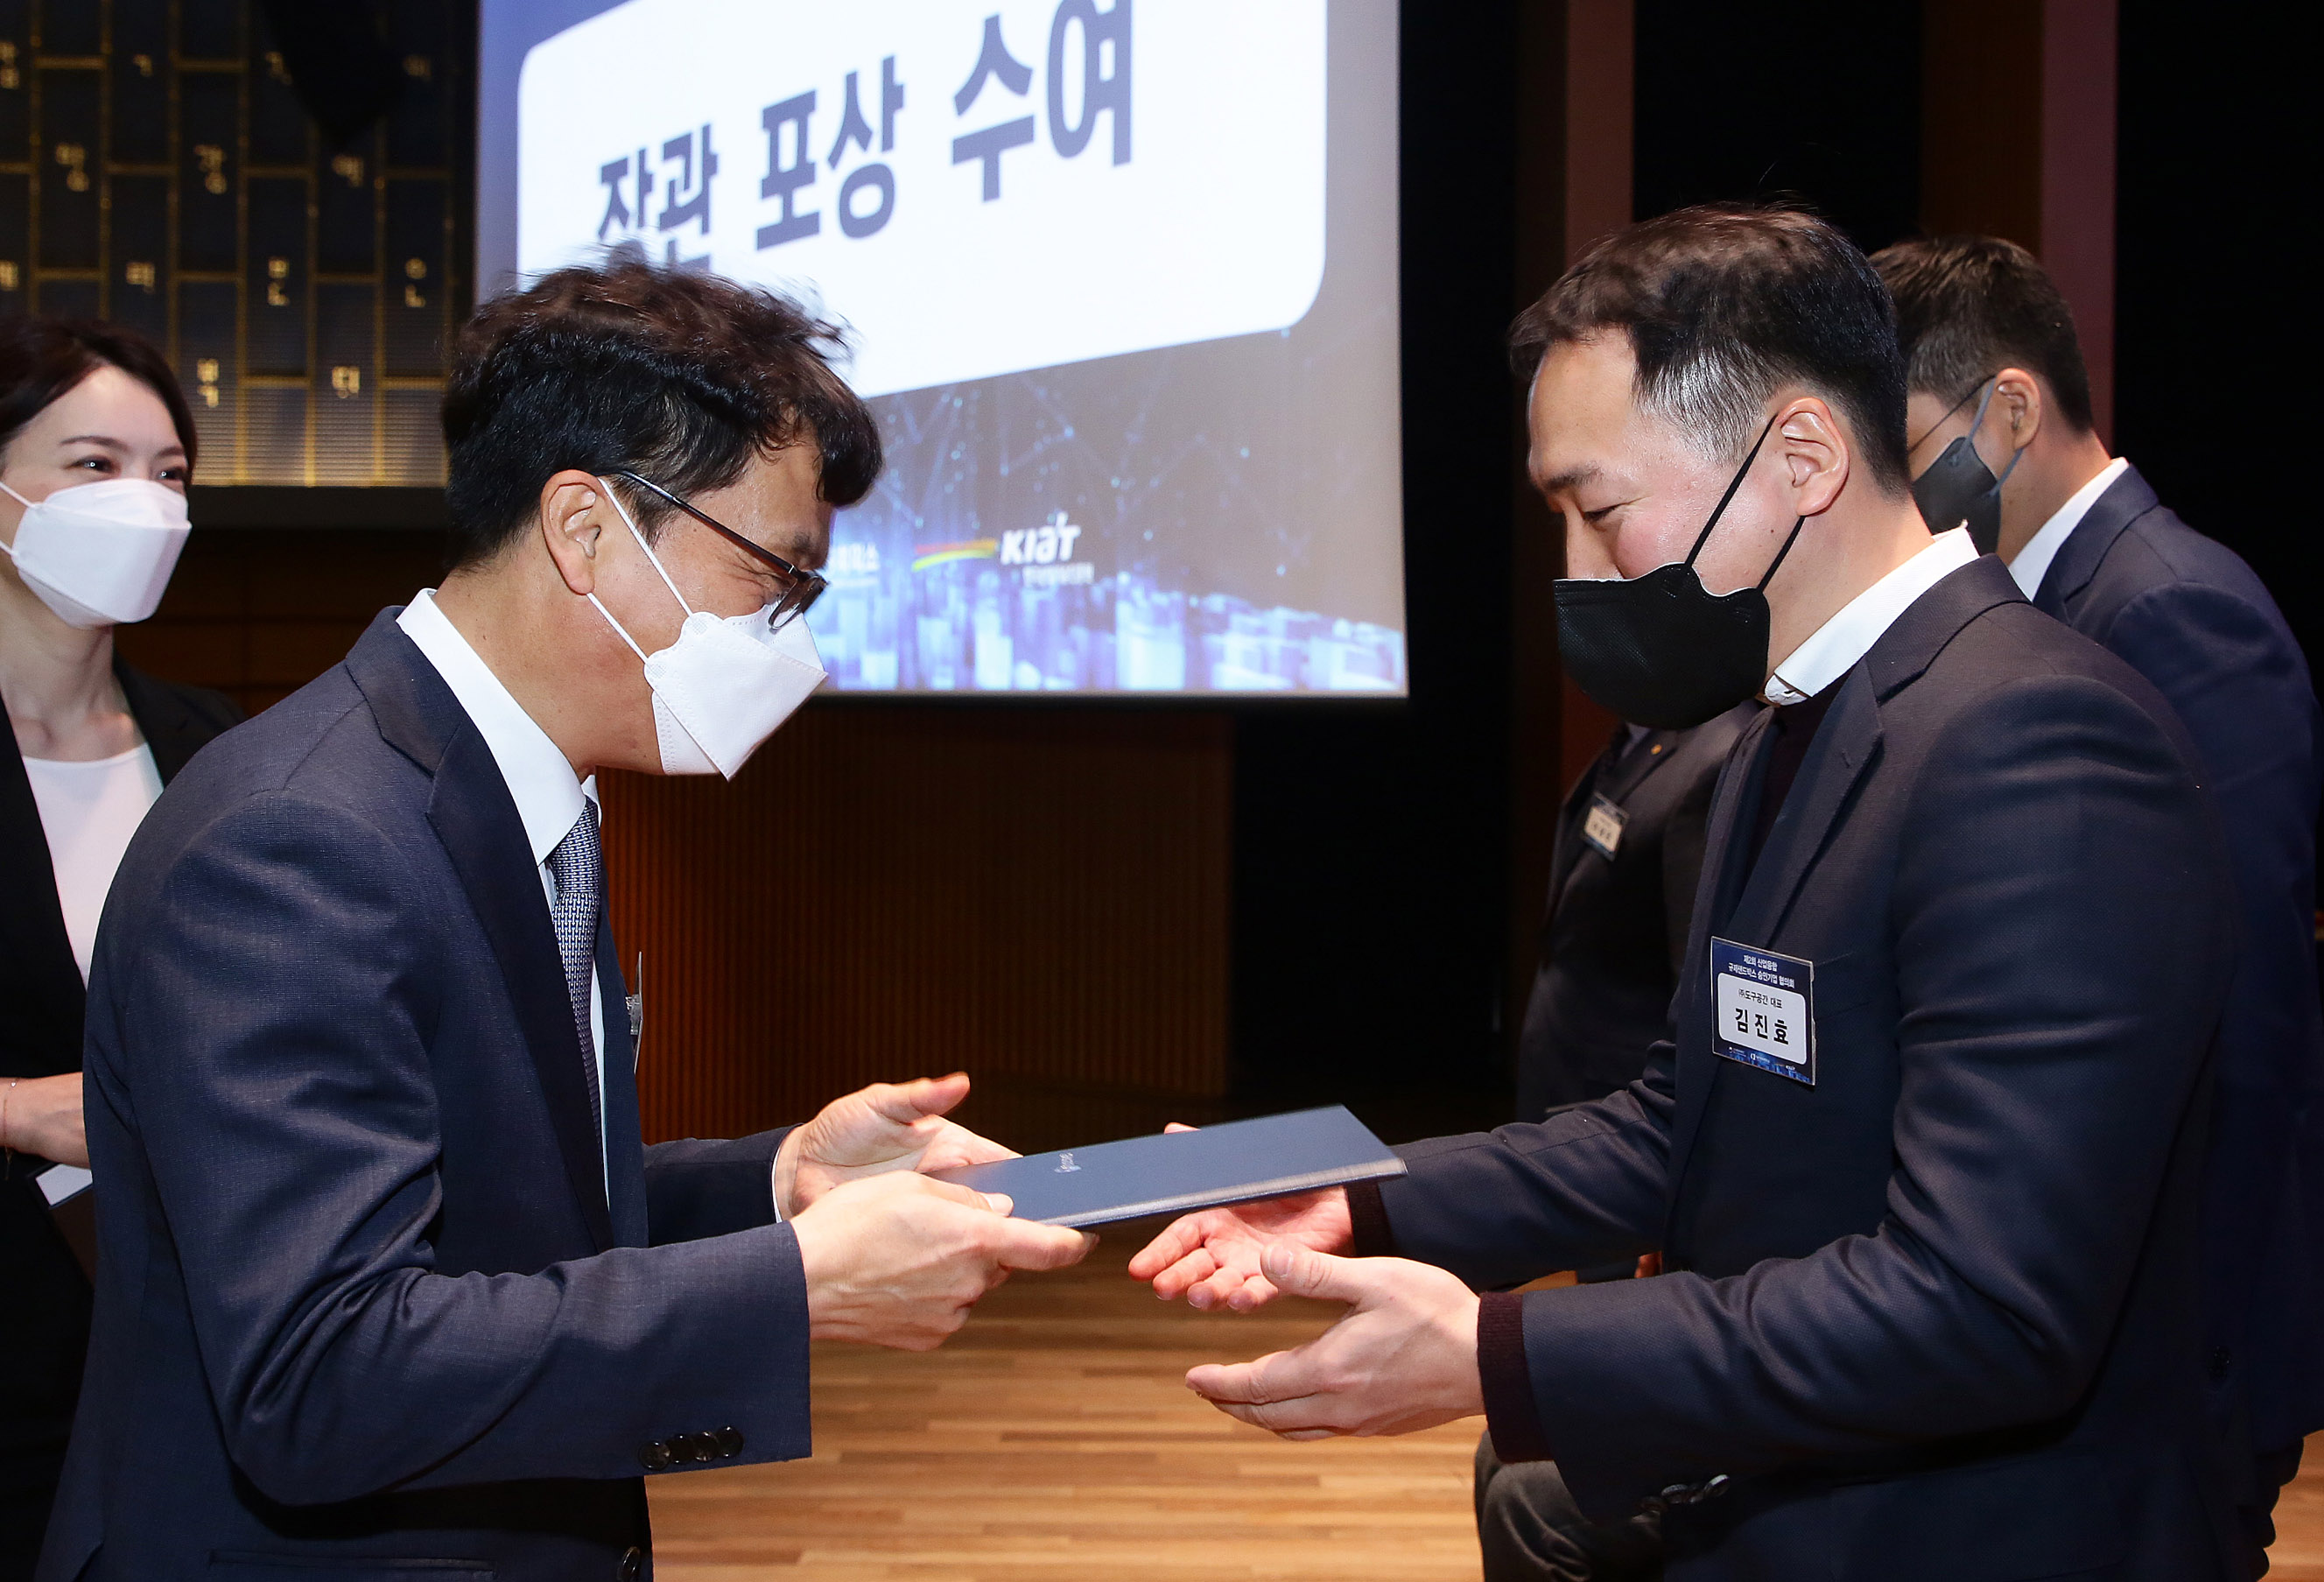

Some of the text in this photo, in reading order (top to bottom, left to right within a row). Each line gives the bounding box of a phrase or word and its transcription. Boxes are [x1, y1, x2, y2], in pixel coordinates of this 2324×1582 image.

[756, 54, 905, 251] 포상
[951, 0, 1133, 203] 수여
[1728, 962, 1757, 979] 규제샌드박스
[1779, 975, 1795, 989] 협의회
[1770, 997, 1782, 1009] 대표
